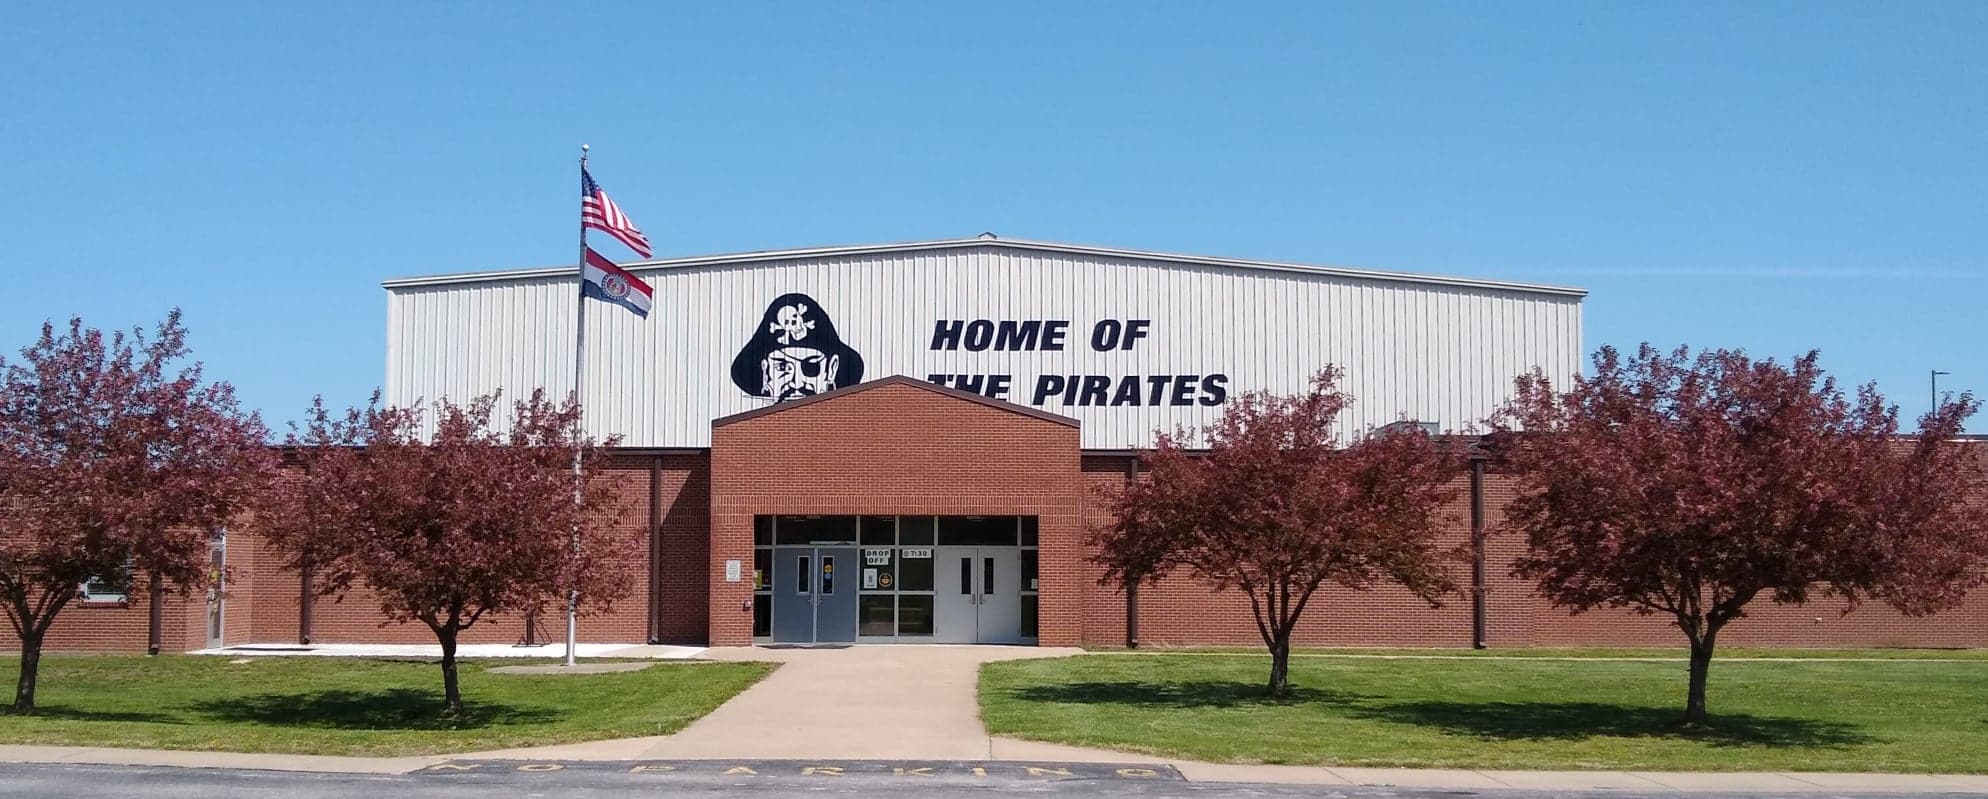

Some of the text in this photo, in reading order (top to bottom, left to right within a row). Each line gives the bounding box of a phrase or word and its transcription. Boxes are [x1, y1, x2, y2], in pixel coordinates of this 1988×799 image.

[930, 319, 1150, 351] HOME OF
[1032, 373, 1228, 407] PIRATES
[427, 763, 1159, 778] NO PARKING
